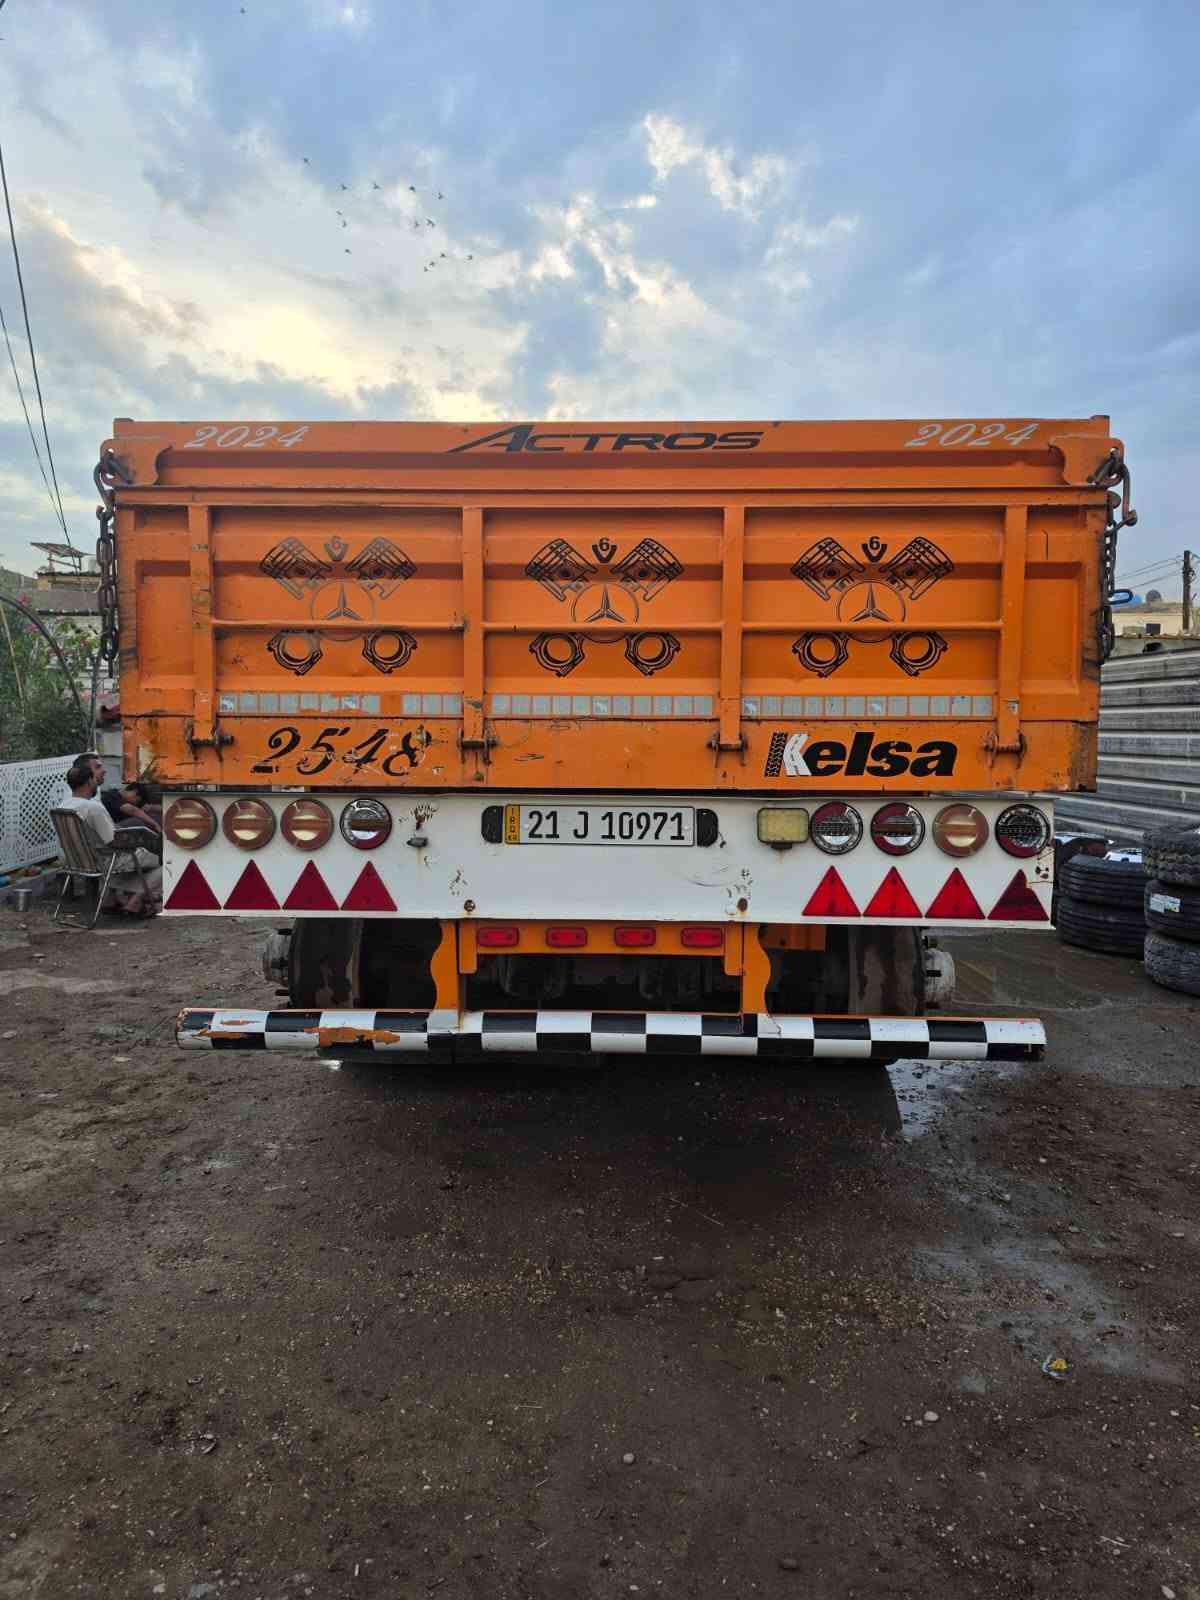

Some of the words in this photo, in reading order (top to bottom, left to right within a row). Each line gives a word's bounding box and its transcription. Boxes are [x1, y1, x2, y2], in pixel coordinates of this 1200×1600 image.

[183, 425, 309, 448] 2024
[903, 423, 1039, 448] 2024
[251, 726, 432, 777] 2548
[764, 731, 958, 777] Kelsa
[528, 811, 559, 839] 21
[573, 811, 589, 839] J
[601, 811, 685, 841] 10971
